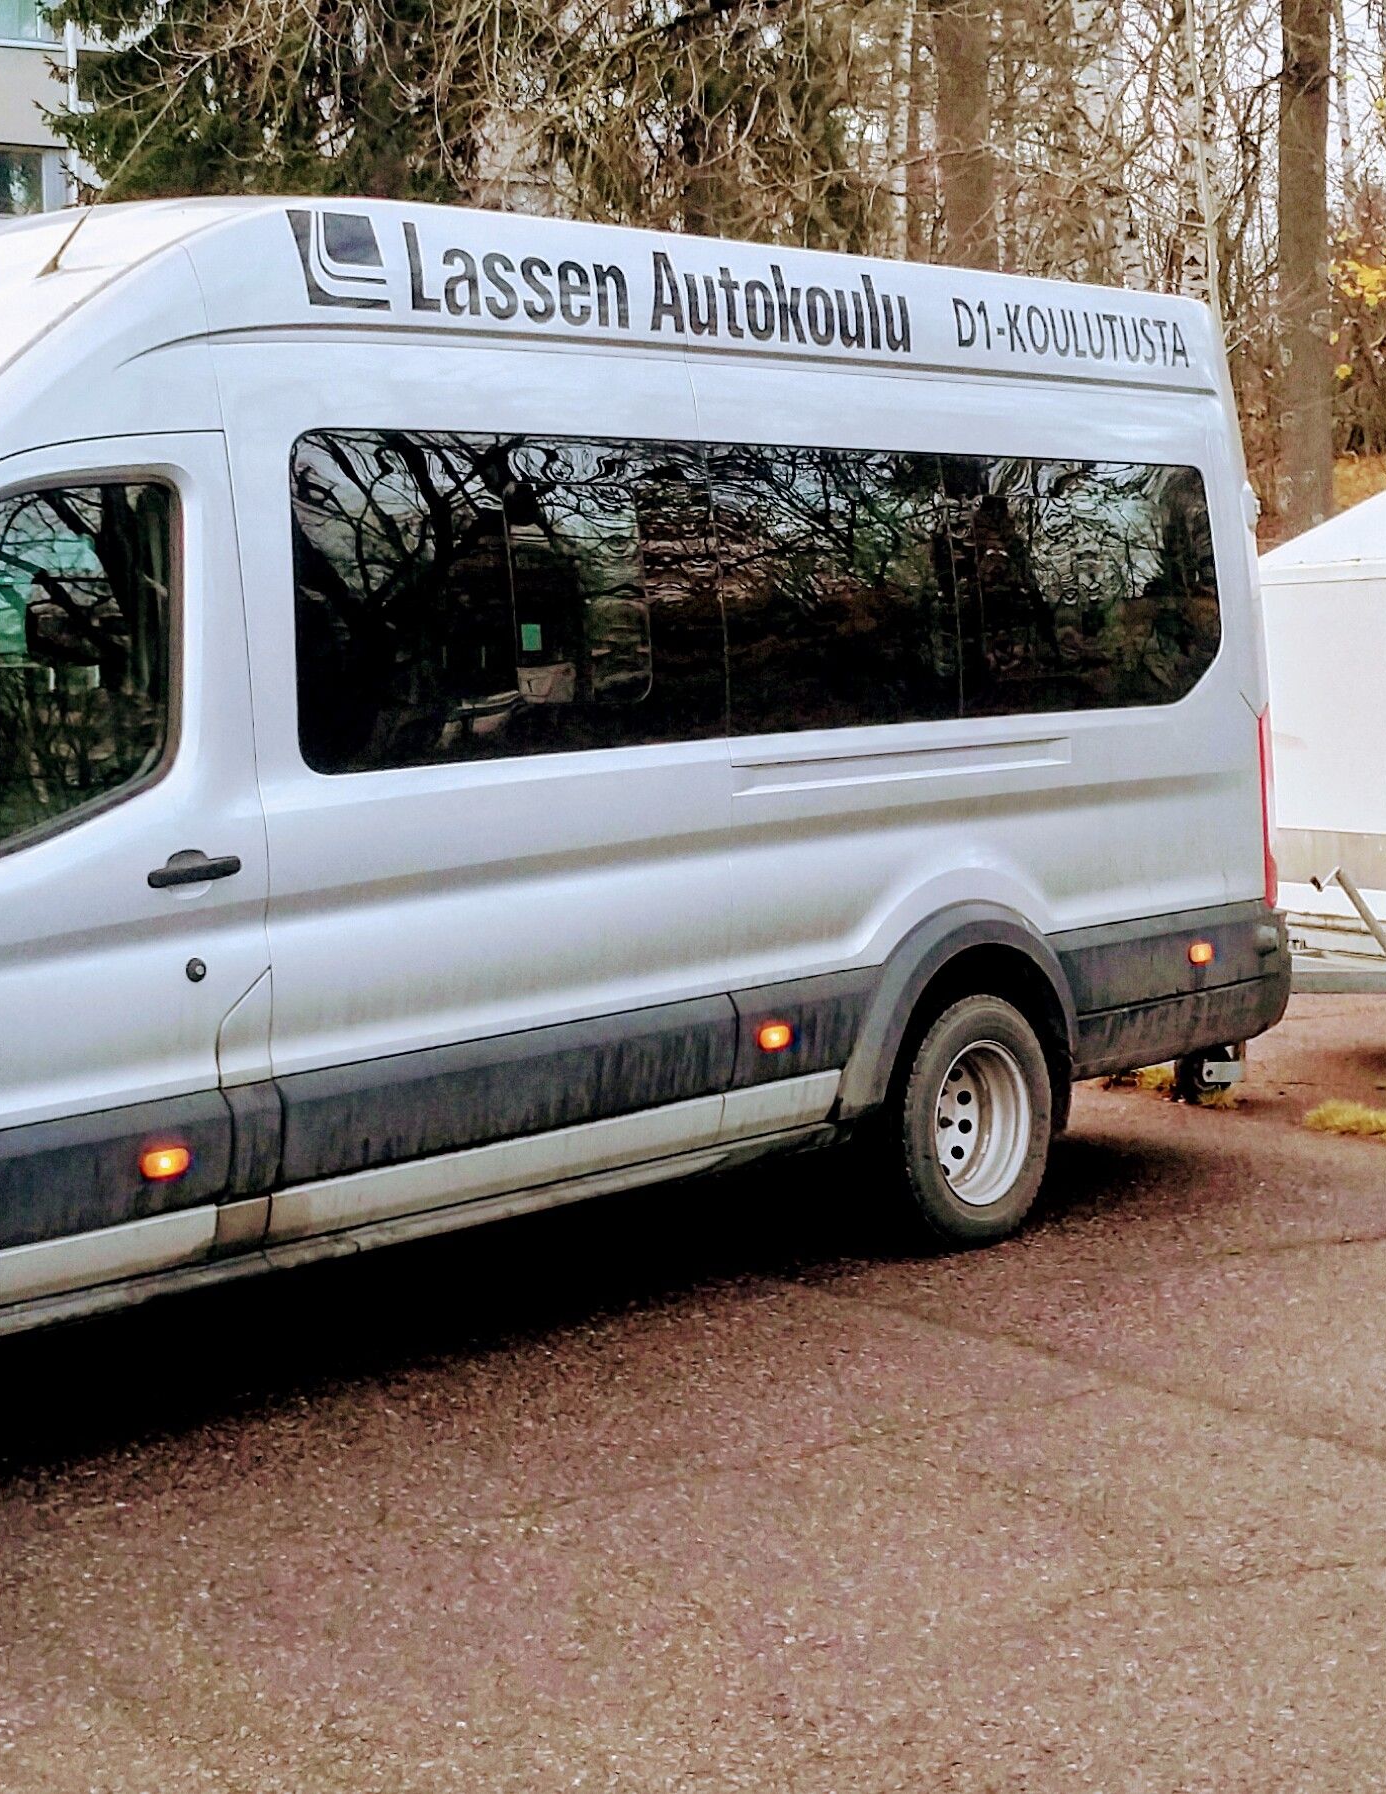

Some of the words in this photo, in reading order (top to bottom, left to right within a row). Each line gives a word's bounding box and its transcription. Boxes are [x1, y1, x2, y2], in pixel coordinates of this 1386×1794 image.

[402, 221, 630, 329] Lassen
[650, 251, 911, 353] Autokoulu
[952, 298, 1190, 368] D1-KOULUTUSTA
